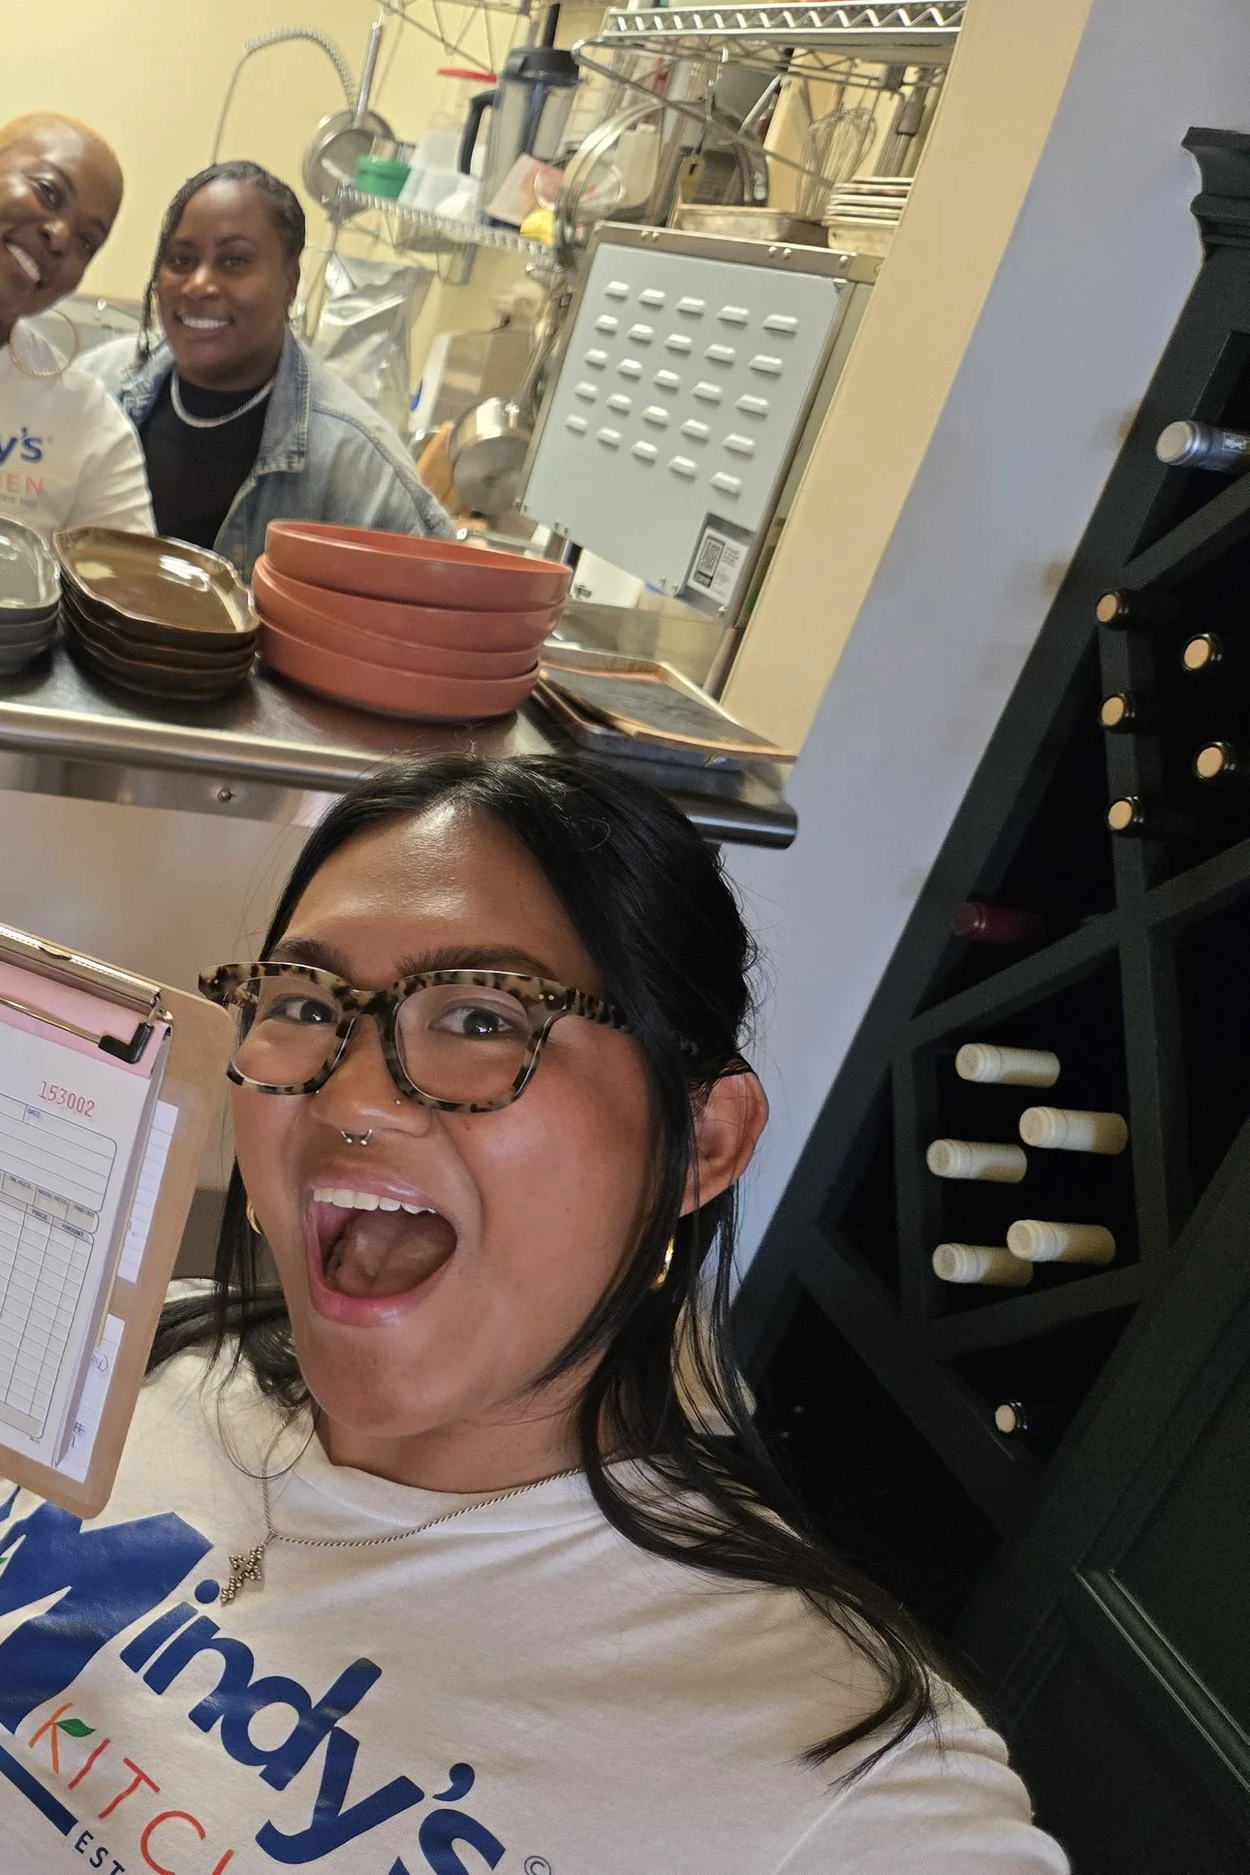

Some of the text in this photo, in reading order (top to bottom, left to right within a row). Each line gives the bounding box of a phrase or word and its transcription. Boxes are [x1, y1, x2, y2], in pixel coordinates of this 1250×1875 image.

[38, 1080, 95, 1118] 153002
[29, 1702, 234, 1875] KITC
[74, 1830, 126, 1875] EST
